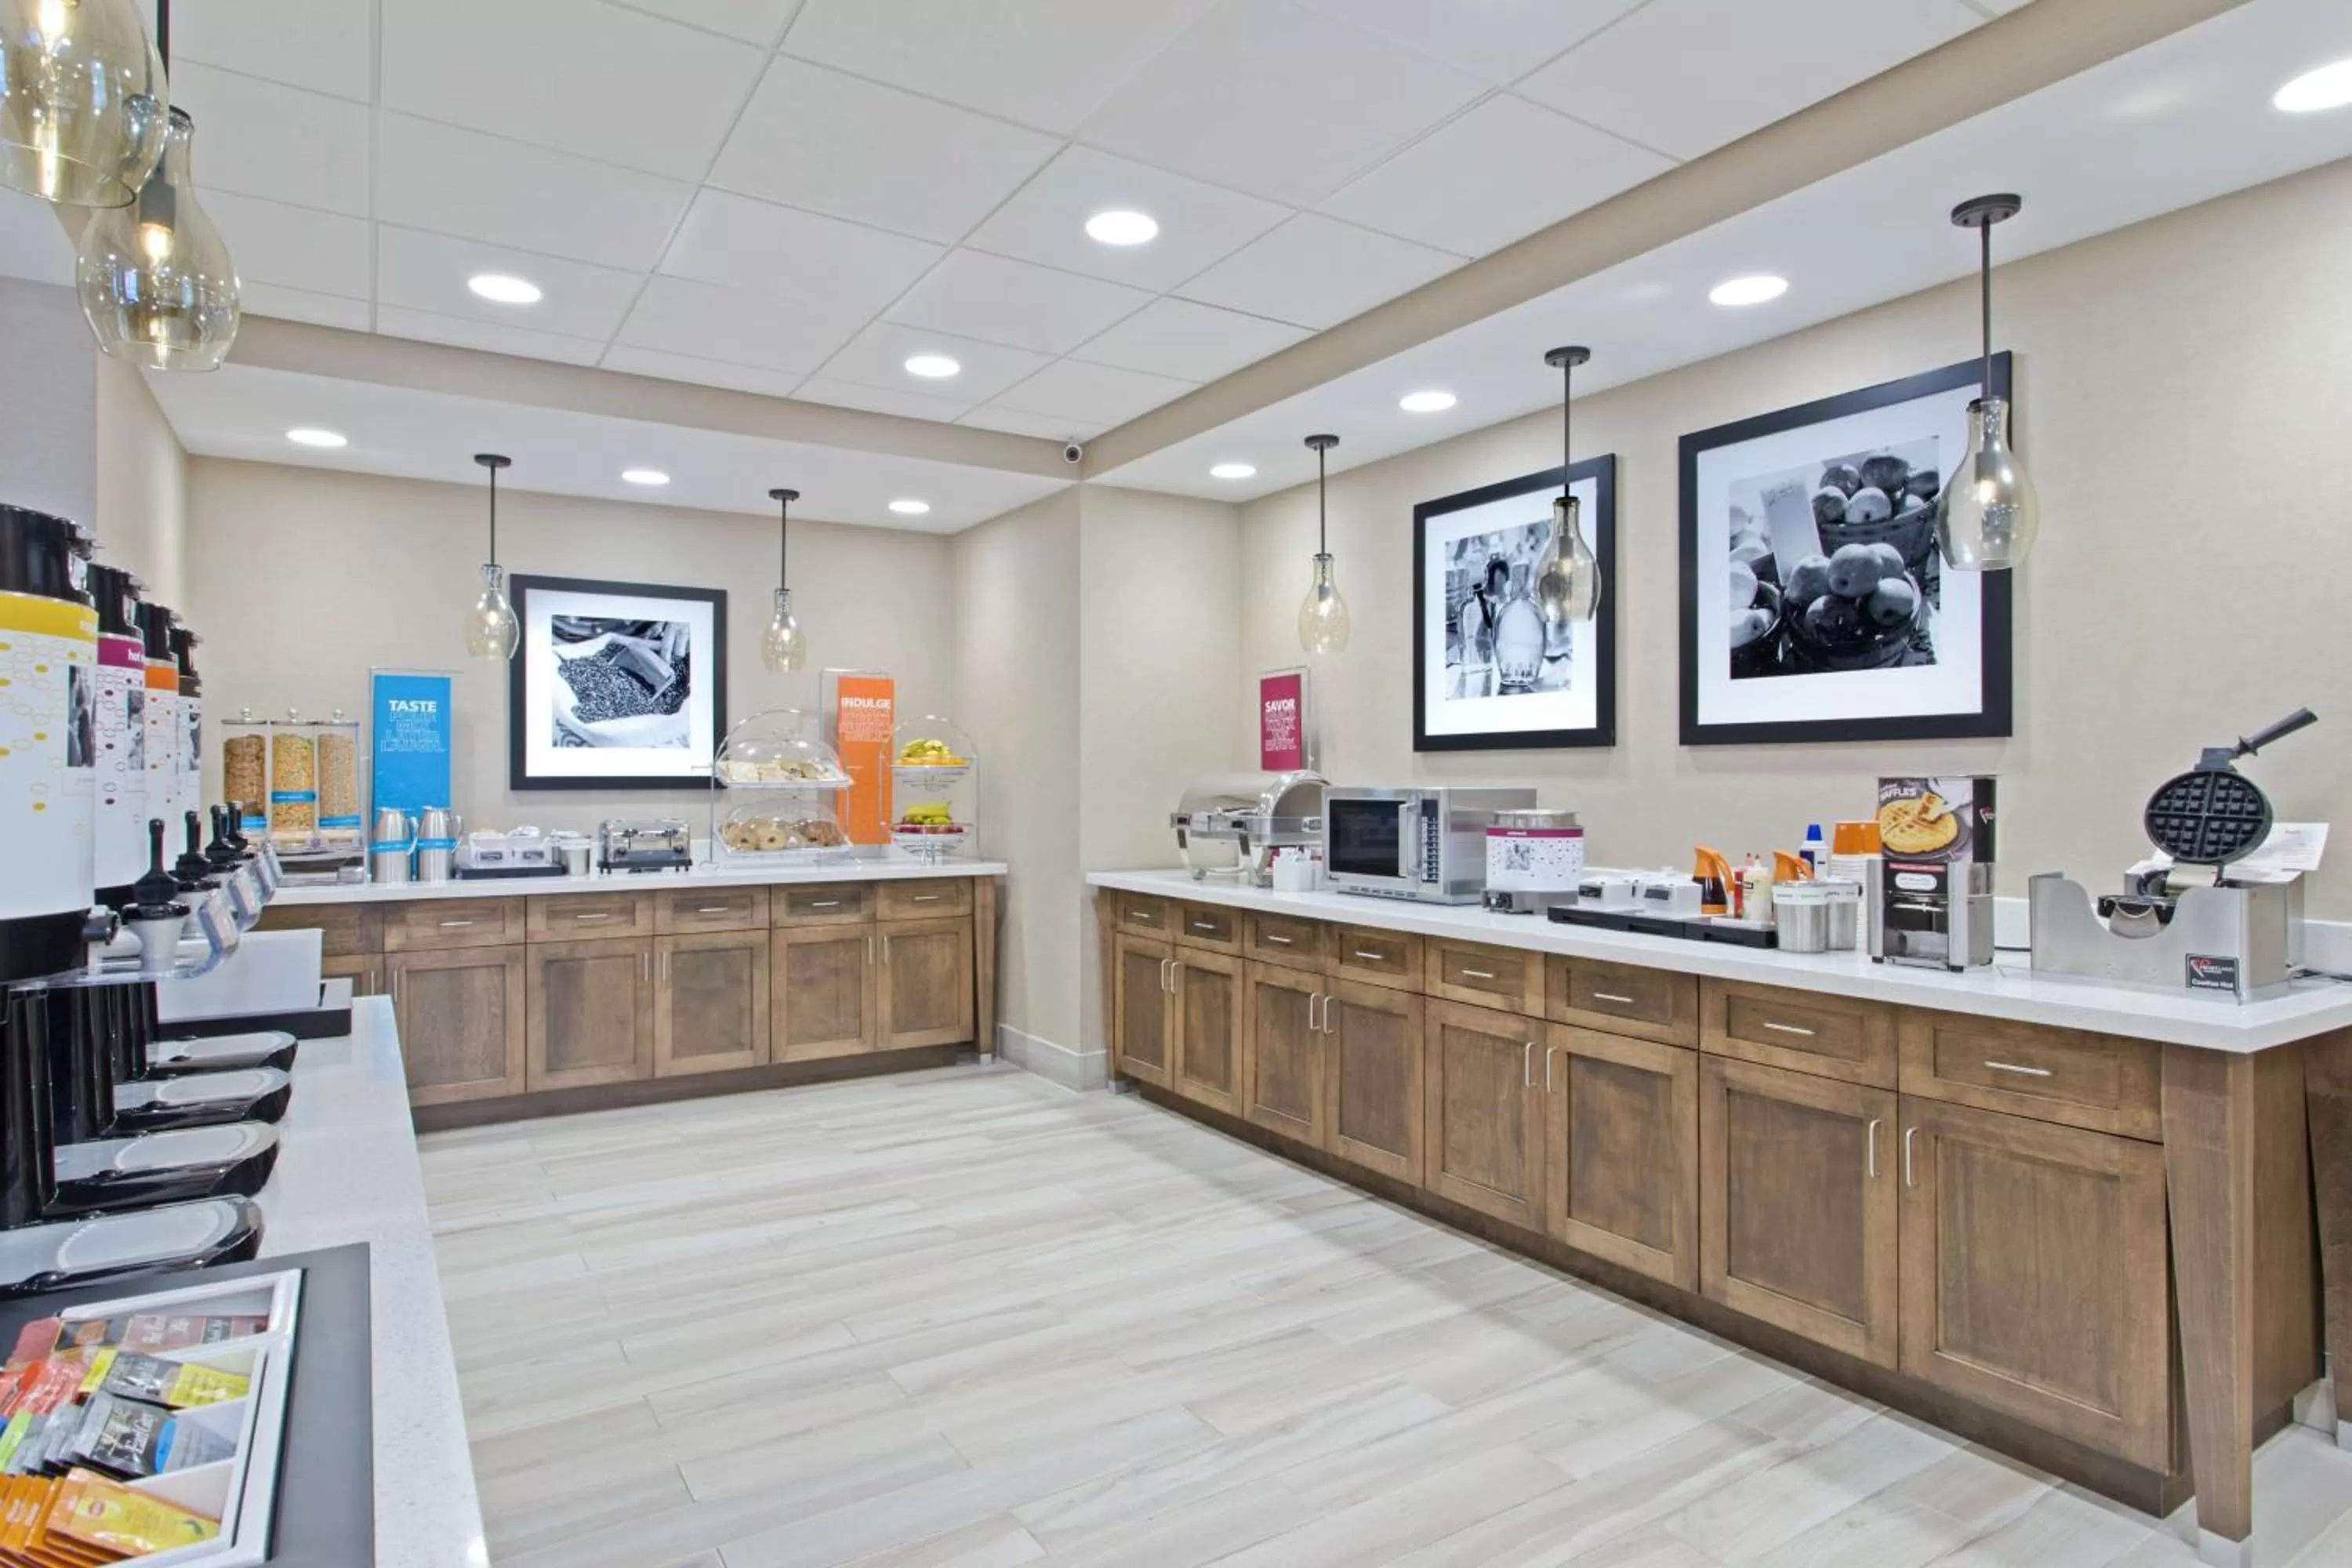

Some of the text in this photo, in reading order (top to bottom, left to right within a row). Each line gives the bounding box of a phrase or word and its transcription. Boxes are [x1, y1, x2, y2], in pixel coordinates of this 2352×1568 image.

[388, 700, 437, 713] TASTE
[840, 697, 891, 710] INDULGE
[1265, 698, 1296, 712] SAVOR
